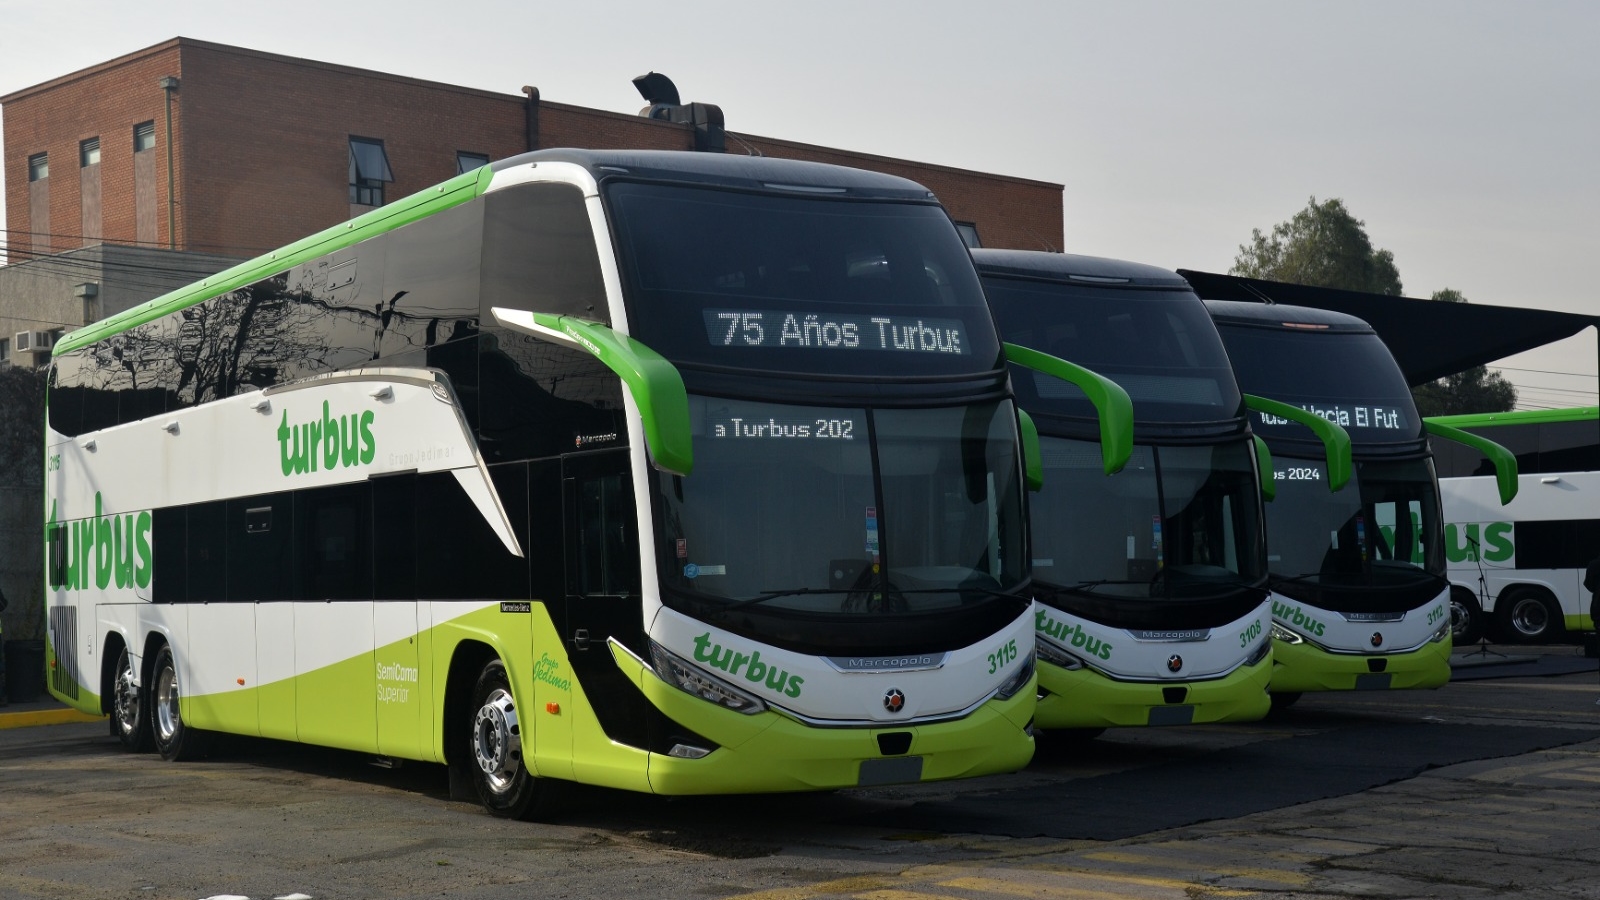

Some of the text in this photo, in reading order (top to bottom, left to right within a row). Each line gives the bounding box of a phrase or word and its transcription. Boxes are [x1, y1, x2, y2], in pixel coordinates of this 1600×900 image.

[718, 312, 961, 354] 75 Años Turbus
[715, 418, 853, 440] a Turbus 202
[1355, 406, 1369, 427] El
[1374, 408, 1400, 429] Fut
[277, 399, 376, 477] turbus
[1287, 468, 1320, 480] 2024
[46, 490, 152, 593] turbus
[1271, 600, 1326, 637] urbus
[1427, 604, 1444, 626] 3112
[1035, 608, 1113, 660] turbus
[1142, 630, 1201, 639] Marcopolo
[1240, 619, 1262, 649] 3108
[693, 631, 805, 699] turbus
[849, 656, 932, 668] Marcopolo
[987, 638, 1018, 675] 3115
[377, 683, 410, 704] Superior
